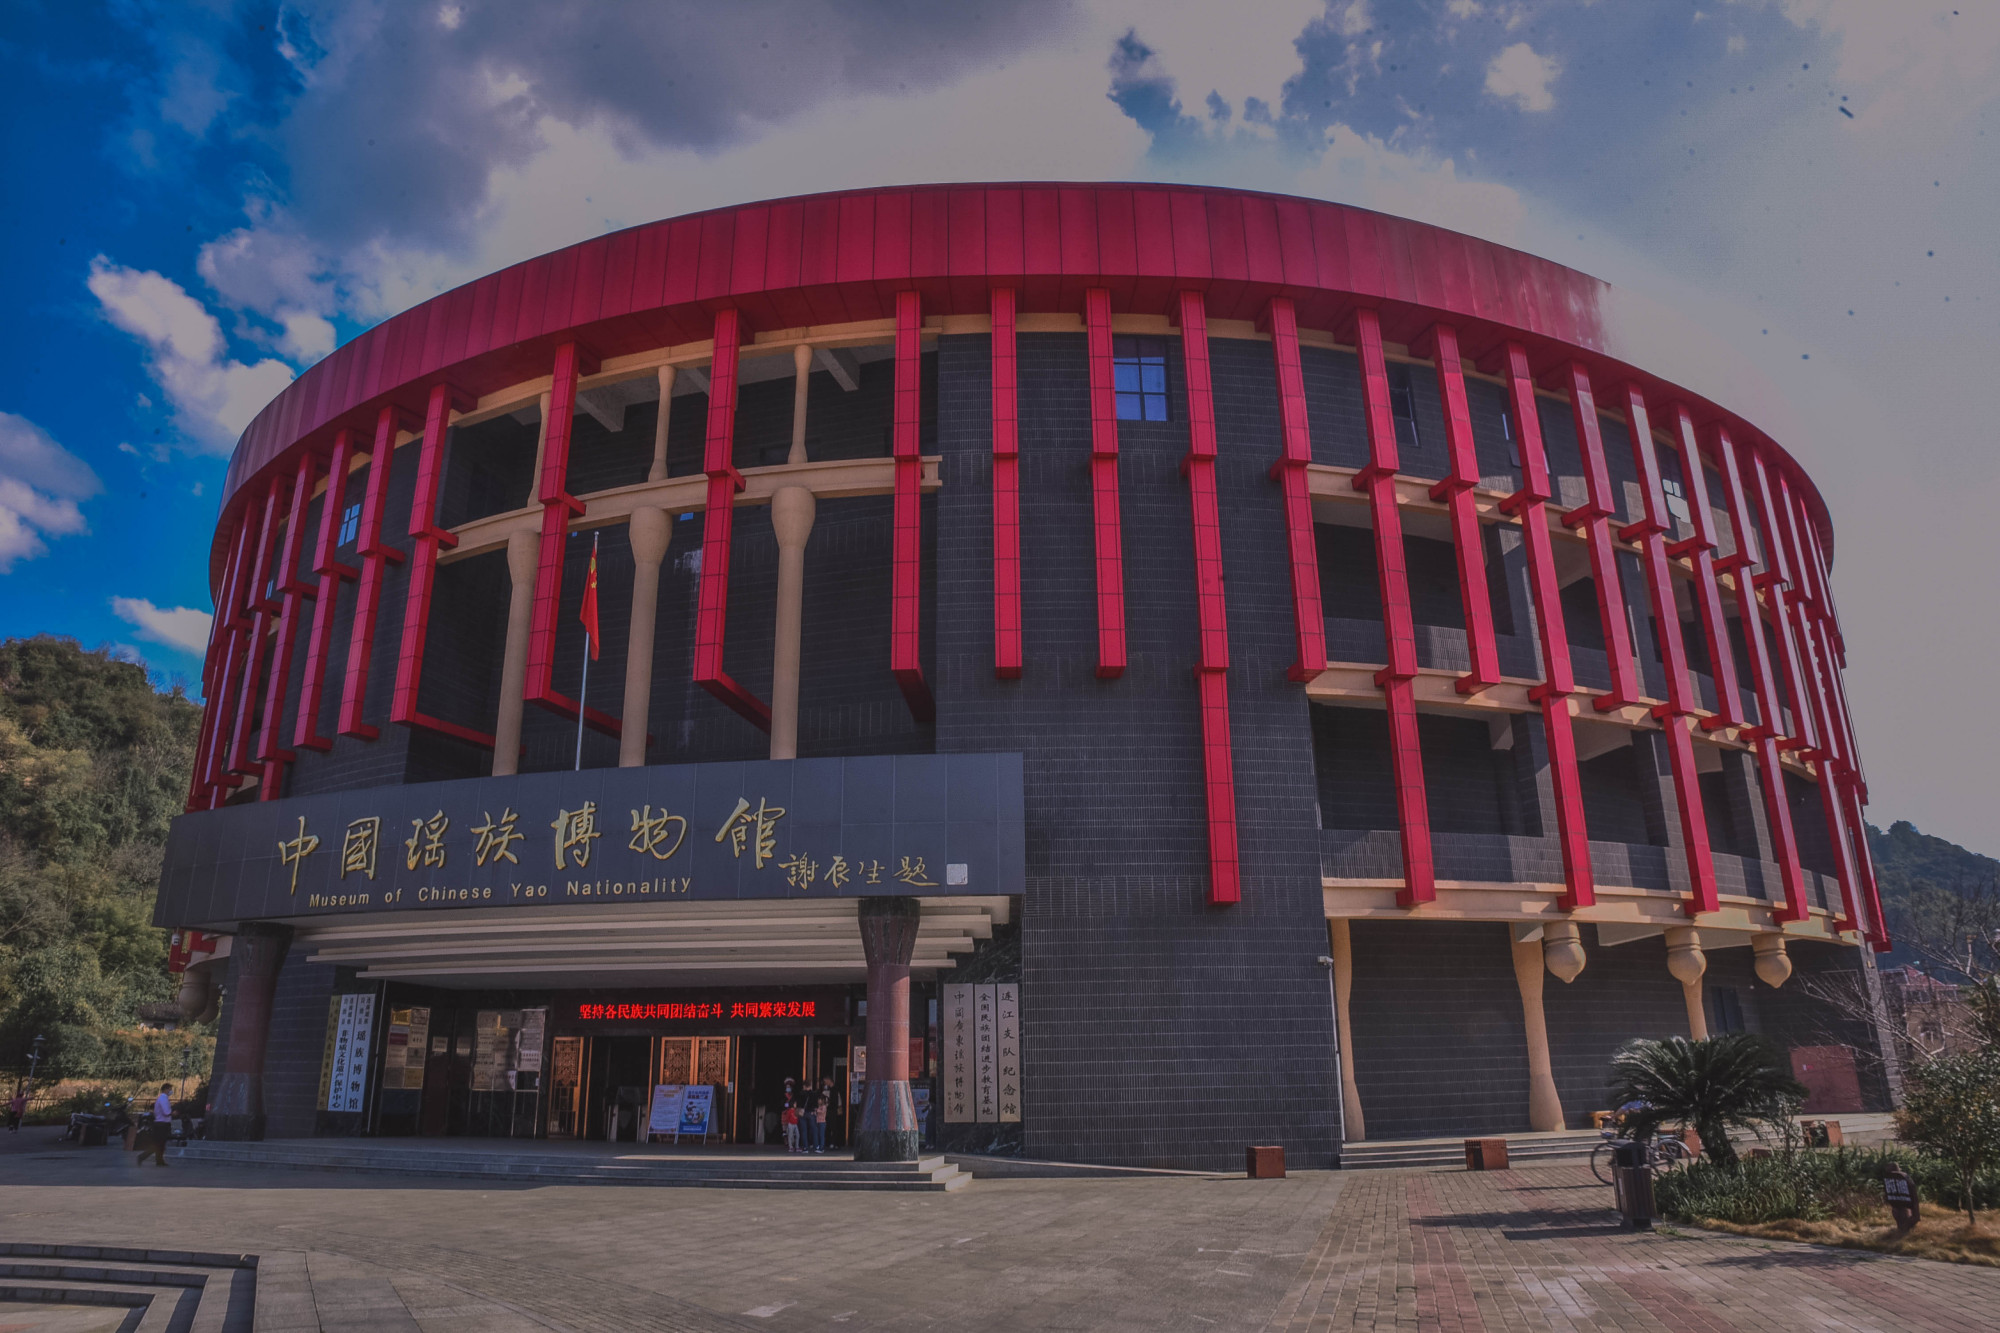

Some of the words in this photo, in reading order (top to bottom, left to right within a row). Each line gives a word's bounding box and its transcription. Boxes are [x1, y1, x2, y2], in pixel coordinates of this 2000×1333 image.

[309, 893, 370, 907] Museum
[384, 888, 402, 904] of
[418, 886, 492, 902] Chinese
[511, 882, 547, 898] Yao
[566, 877, 691, 896] Nationality
[579, 1003, 724, 1020] 坚持各民族共同团结奋斗
[730, 1001, 816, 1018] 共同繁荣发展
[349, 1030, 367, 1109] 瑶族博物馆
